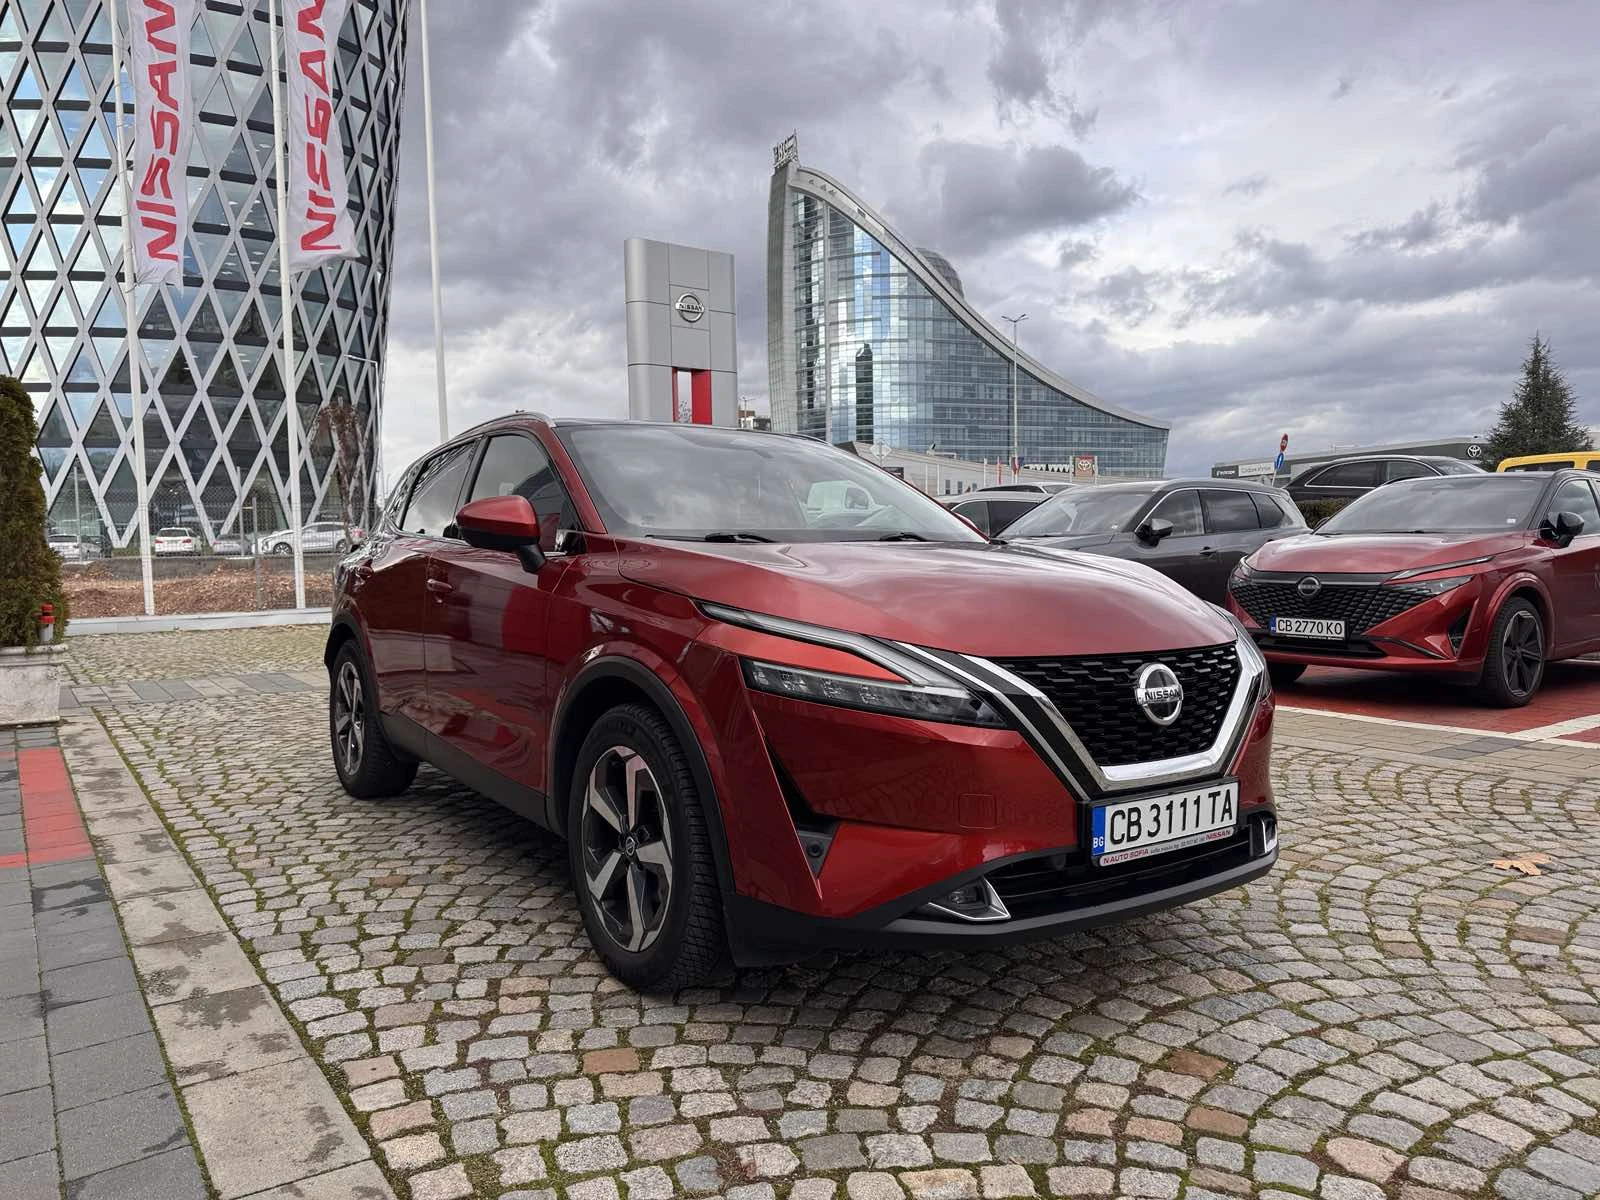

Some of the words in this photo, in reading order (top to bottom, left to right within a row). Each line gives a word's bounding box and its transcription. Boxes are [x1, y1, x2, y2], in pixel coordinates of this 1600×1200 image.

[136, 0, 180, 262] NISSAN
[679, 303, 702, 311] NISSAN
[1278, 620, 1293, 632] CB
[1295, 620, 1324, 634] 2770
[1326, 622, 1342, 635] KO
[1145, 689, 1180, 700] NISSAN
[1110, 807, 1142, 844] CB
[1147, 795, 1201, 837] 3111
[1208, 789, 1234, 825] TA
[1205, 830, 1231, 841] NISSAN
[1093, 837, 1104, 848] BG
